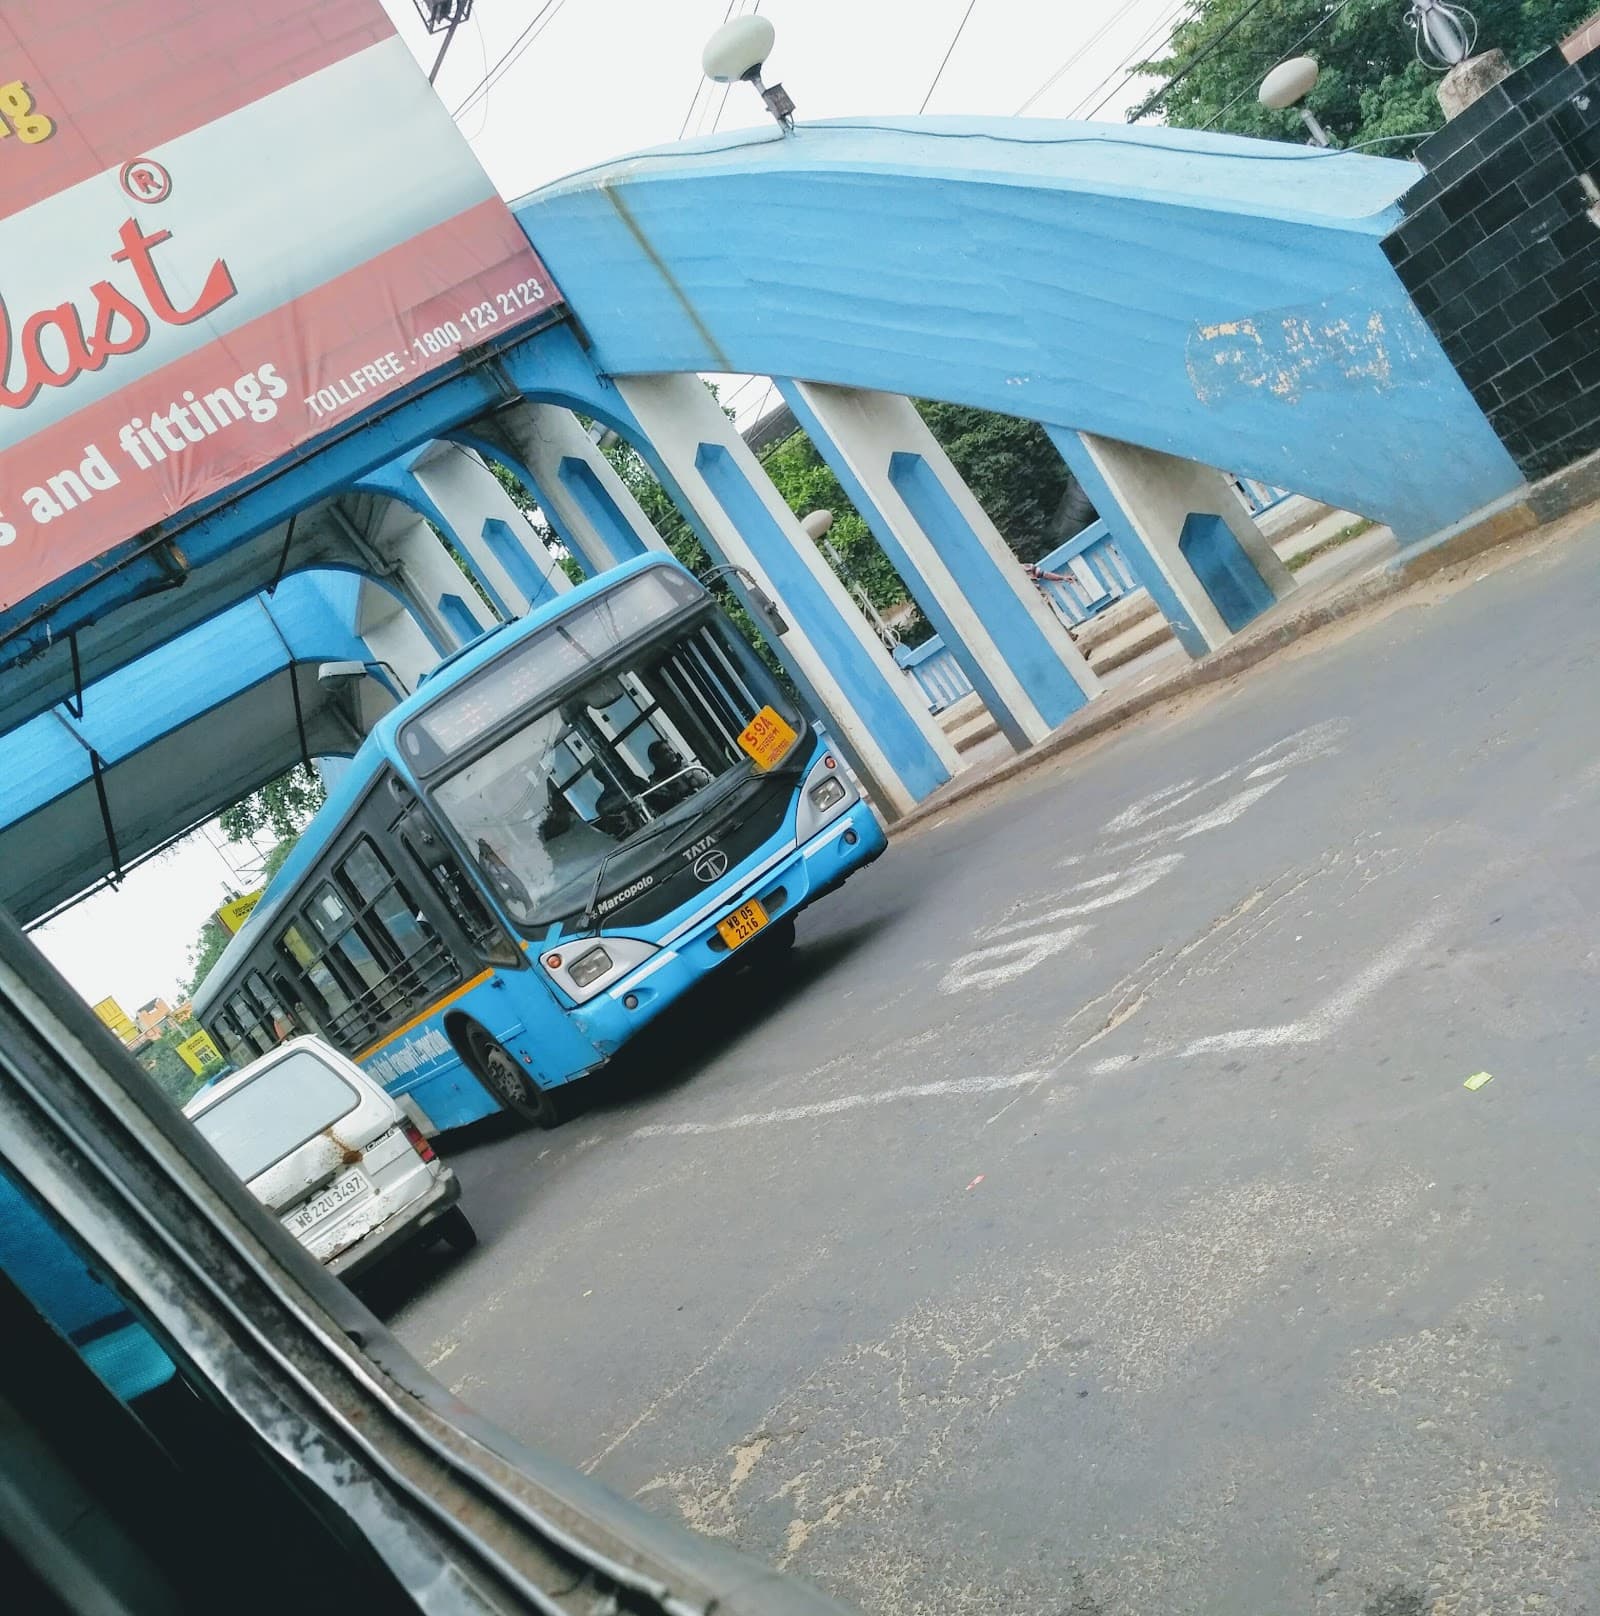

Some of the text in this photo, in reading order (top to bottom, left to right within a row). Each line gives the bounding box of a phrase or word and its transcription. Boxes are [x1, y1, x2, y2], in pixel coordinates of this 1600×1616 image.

[303, 351, 405, 418] TOLLFREE
[412, 321, 462, 358] 1800
[460, 301, 499, 333] 123
[496, 278, 545, 316] 2123
[22, 444, 121, 524] and
[118, 363, 288, 471] fittings
[682, 835, 716, 861] TATA
[597, 875, 654, 915] Marcopolo
[726, 906, 754, 929] WB 05
[735, 917, 759, 940] 2216
[295, 1177, 361, 1229] WB 22U 3497
